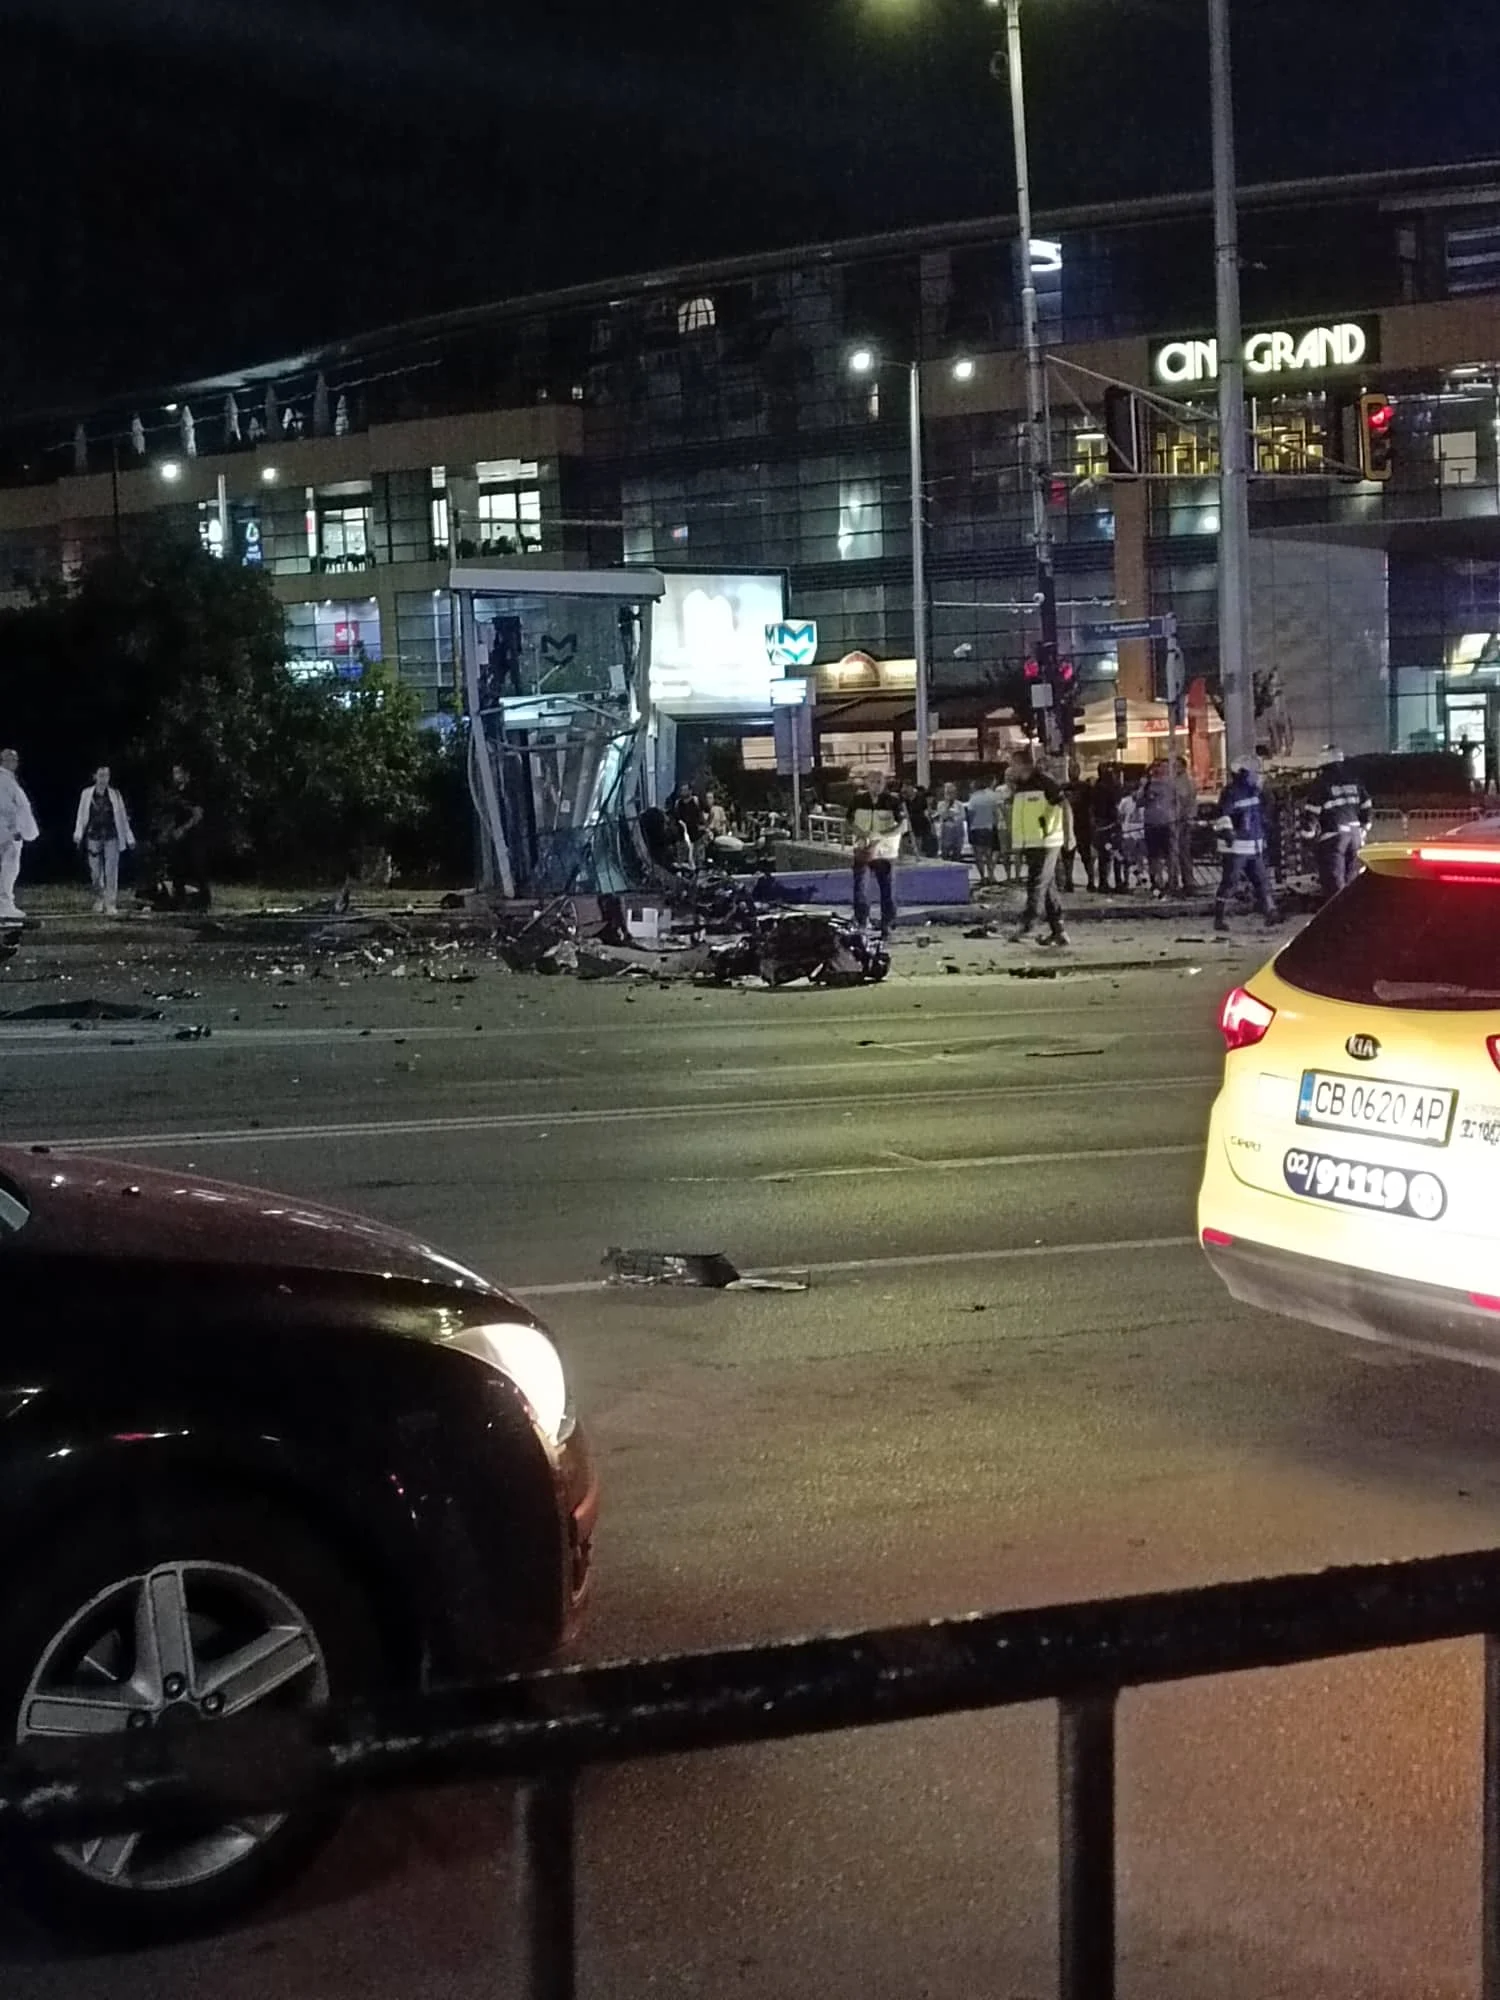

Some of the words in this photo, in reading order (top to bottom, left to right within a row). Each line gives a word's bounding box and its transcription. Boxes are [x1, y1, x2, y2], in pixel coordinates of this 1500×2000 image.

[1157, 338, 1218, 382] CIN
[1245, 323, 1367, 373] GRAND
[1349, 1036, 1376, 1058] KIA
[1315, 1082, 1346, 1115] CB
[1350, 1085, 1407, 1126] 0620
[1412, 1097, 1444, 1130] AP
